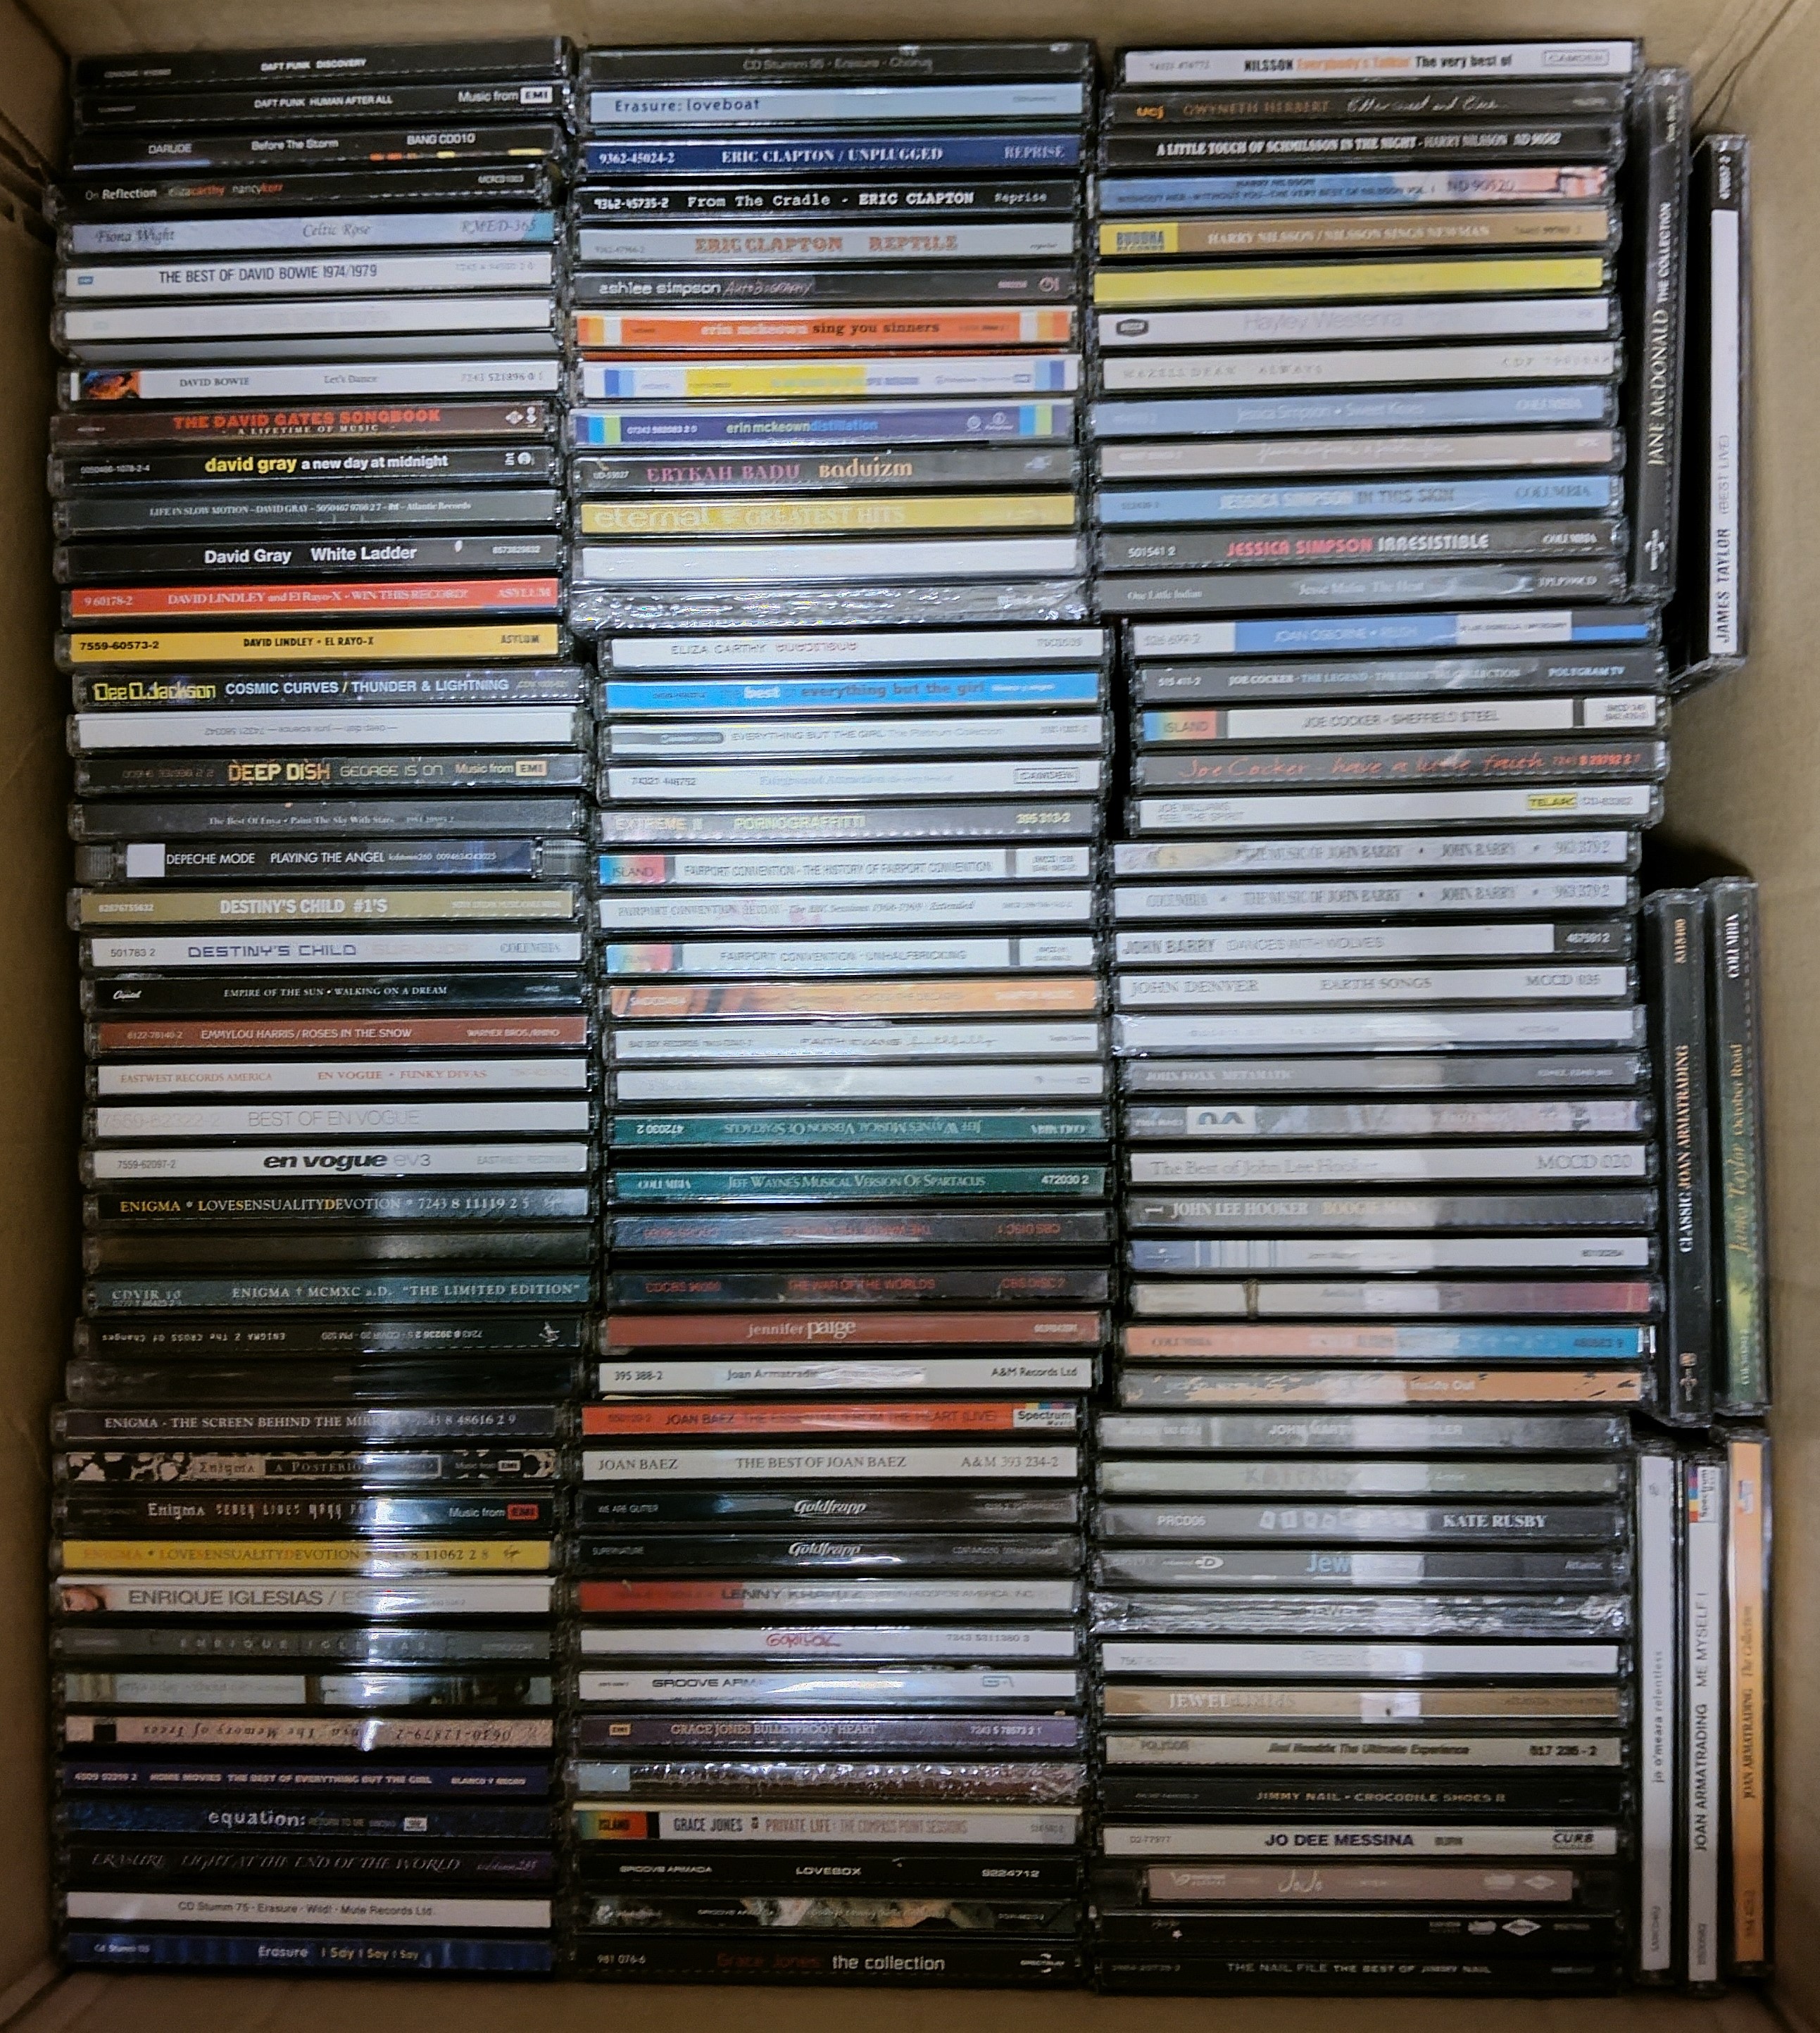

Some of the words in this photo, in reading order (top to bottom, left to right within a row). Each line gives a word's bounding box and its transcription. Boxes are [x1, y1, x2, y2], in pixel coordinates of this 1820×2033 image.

[1244, 59, 1293, 71] NILSSON
[1415, 55, 1438, 68] The
[1441, 56, 1466, 70] very
[1471, 54, 1497, 66] best
[1500, 54, 1512, 65] of
[255, 99, 278, 108] DAFT
[280, 98, 305, 108] PUNK
[310, 97, 343, 106] HUMAN
[345, 96, 373, 106] AFTER
[375, 94, 392, 104] ALL
[458, 92, 490, 102] Music
[493, 90, 518, 101] from
[615, 99, 680, 113] Erasure:
[687, 99, 759, 111] loveboat
[600, 152, 674, 164] 9362-45024-2
[722, 149, 758, 163] ERIC
[762, 149, 834, 162] CLAPTON
[848, 146, 943, 161] UNPLUGGED
[1005, 146, 1064, 159] REPRISE
[688, 196, 727, 207] From
[735, 195, 765, 206] The
[772, 194, 830, 206] Cradle
[859, 194, 897, 205] ERIC
[906, 192, 974, 204] CLAPTON
[995, 191, 1047, 203] Reprise
[696, 239, 741, 253] ERIC
[744, 238, 842, 252] CLAPTON
[869, 236, 957, 251] REPTILE
[1657, 203, 1671, 277] COLLECTION
[159, 272, 183, 284] THE
[187, 270, 216, 282] BEST
[219, 270, 236, 282] OF
[239, 268, 276, 280] DAVID
[279, 266, 318, 279] BOWIE
[322, 265, 377, 278] 1974/1979
[599, 283, 653, 294] ashlee
[656, 282, 721, 296] simpson
[1657, 280, 1669, 303] THE
[812, 322, 844, 336] sing
[851, 323, 877, 334] you
[884, 322, 939, 332] sinners
[1649, 309, 1669, 416] McDONALD
[172, 415, 208, 429] THE
[213, 413, 268, 428] DAVID
[275, 413, 334, 427] GATES
[340, 408, 441, 425] SONGBOOK
[1648, 422, 1667, 467] JANE
[206, 454, 253, 472] david
[258, 457, 297, 475] gray
[302, 460, 310, 469] a
[313, 458, 339, 470] new
[343, 455, 369, 471] day
[371, 454, 384, 468] at
[387, 454, 448, 469] midnight
[646, 467, 733, 482] ERYKAH
[741, 465, 800, 479] BADU
[819, 458, 912, 477] Baduizm
[205, 549, 250, 563] David
[254, 548, 291, 565] Gray
[311, 546, 356, 560] White
[360, 545, 416, 560] Ladder
[1226, 542, 1291, 558] JESSICA
[1295, 539, 1372, 555] SIMPSON
[1378, 535, 1489, 551] IRRESISTIBLE
[1714, 528, 1730, 583] TAYLOR
[1715, 591, 1731, 643] JAMES
[80, 639, 159, 650] 7559-60573-2
[244, 637, 274, 648] DAVID
[277, 636, 313, 647] LINDLEY
[325, 636, 336, 646] EL
[338, 635, 373, 646] RAYO-X
[225, 682, 279, 696] COSMIC
[283, 682, 338, 694] CURVES
[353, 680, 417, 693] THUNDER
[421, 681, 431, 692] &
[436, 679, 508, 692] LIGHTNING
[228, 762, 280, 781] DEEP
[286, 760, 330, 781] DISH
[166, 852, 215, 866] DEPECHE
[220, 852, 255, 864] MODE
[270, 852, 318, 864] PLAYING
[321, 851, 341, 864] THE
[345, 850, 384, 863] ANGEL
[220, 899, 296, 914] DESTINY'S
[301, 899, 345, 913] CHILD
[353, 898, 387, 913] #1'S
[188, 945, 290, 957] DESTINY'S
[299, 944, 356, 956] CHILD
[1726, 914, 1740, 978] COLUMBIA
[201, 1028, 253, 1039] EMMYLOU
[342, 1028, 352, 1038] IN
[356, 1028, 375, 1038] THE
[378, 1028, 412, 1038] SNOW
[1676, 1045, 1691, 1148] ARMATRADING
[263, 1154, 299, 1169] en
[303, 1152, 388, 1171] vogue
[1678, 1152, 1692, 1189] JOAN
[120, 1200, 180, 1212] ENIGMA
[1172, 1203, 1211, 1218] JOHN
[1216, 1202, 1241, 1216] LEE
[1245, 1202, 1307, 1214] HOOKER
[1679, 1192, 1692, 1252] CLASSIC
[232, 1287, 288, 1298] ENIGMA
[308, 1285, 360, 1297] MCMXC
[403, 1285, 439, 1296] "THE
[444, 1284, 505, 1296] LIMITED
[510, 1283, 579, 1295] EDITION"
[748, 1323, 804, 1338] jennifer
[807, 1320, 856, 1339] paige
[991, 1367, 1017, 1377] A&M
[1019, 1368, 1055, 1377] Records
[1059, 1367, 1077, 1376] Ltd
[105, 1416, 158, 1429] ENIGMA
[171, 1418, 198, 1428] THE
[202, 1417, 253, 1428] SCREEN
[258, 1416, 310, 1428] BEHIND
[315, 1416, 341, 1428] THE
[1018, 1411, 1072, 1423] Spectrum
[598, 1459, 636, 1471] JOAN
[639, 1459, 677, 1470] BAEZ
[736, 1458, 760, 1469] THE
[763, 1458, 801, 1469] BEST
[804, 1457, 824, 1468] OF
[827, 1457, 863, 1469] JOAN
[867, 1457, 906, 1468] BAEZ
[148, 1503, 205, 1518] Enigma
[794, 1499, 866, 1516] Goldfrapp
[1444, 1515, 1487, 1527] KATE
[1492, 1515, 1546, 1529] RUSBY
[789, 1542, 860, 1558] Goldfrapp
[129, 1591, 224, 1605] ENRIQUE
[228, 1590, 323, 1605] IGLESIAS
[1694, 1601, 1708, 1661] MYSELF
[1694, 1664, 1708, 1687] ME
[1652, 1716, 1664, 1766] o'meara
[1694, 1704, 1708, 1810] ARMATRADING
[1651, 1770, 1665, 1783] jo
[208, 1811, 305, 1827] equation:
[674, 1818, 705, 1832] GRACE
[710, 1818, 742, 1832] JONES
[1265, 1834, 1288, 1847] JO
[1294, 1834, 1329, 1846] DEE
[1335, 1834, 1414, 1846] MESSINA
[1695, 1814, 1708, 1851] JOAN
[832, 1953, 859, 1970] the
[865, 1954, 945, 1970] collection
